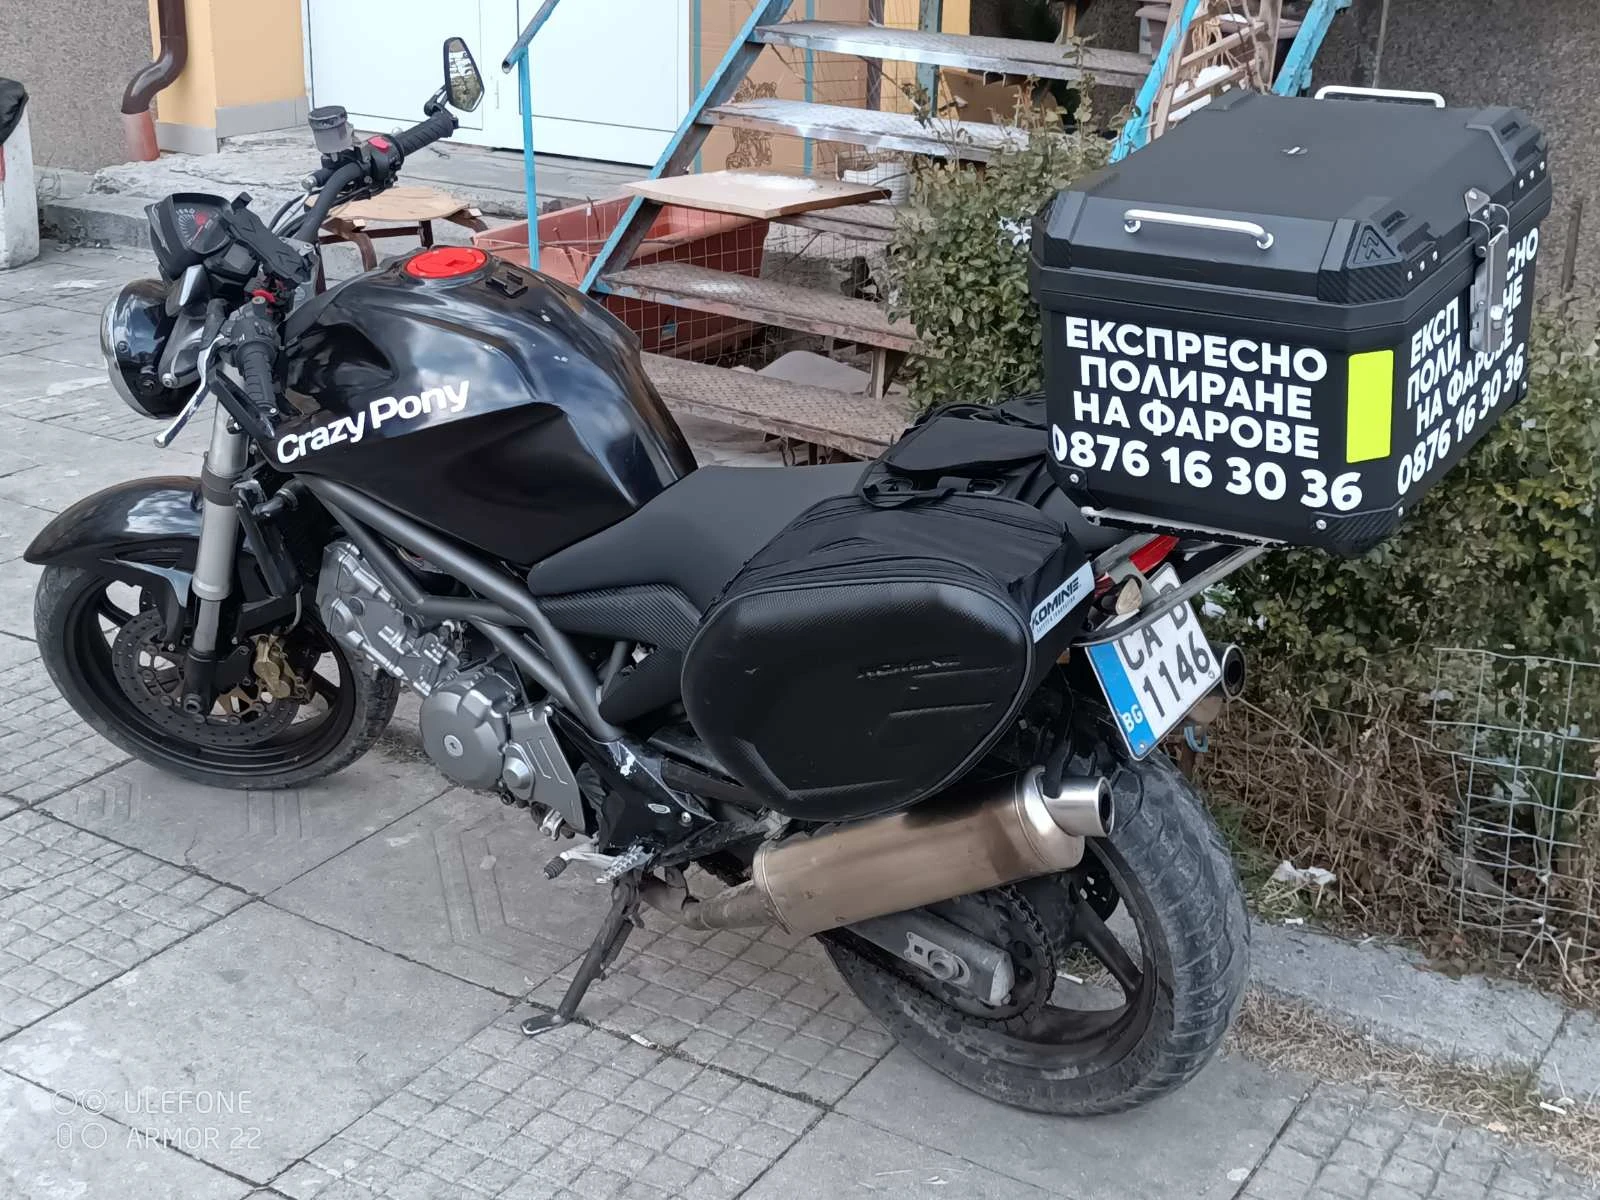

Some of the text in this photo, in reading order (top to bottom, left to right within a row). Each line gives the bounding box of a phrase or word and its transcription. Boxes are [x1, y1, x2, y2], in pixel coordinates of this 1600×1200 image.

[1066, 316, 1328, 382] ЕКСПРЕСНО
[1080, 354, 1312, 420] ПОЛИРАНЕ
[1397, 342, 1525, 496] 0876 16 30 36
[1416, 387, 1444, 437] НА
[277, 380, 470, 464] Crazy Pony
[1073, 390, 1320, 460] НА ФАРОВЕ
[1052, 423, 1363, 512] 0876 16 30 36
[1031, 576, 1079, 630] KOMINE
[1142, 630, 1210, 718] 1146
[1121, 704, 1143, 732] BG
